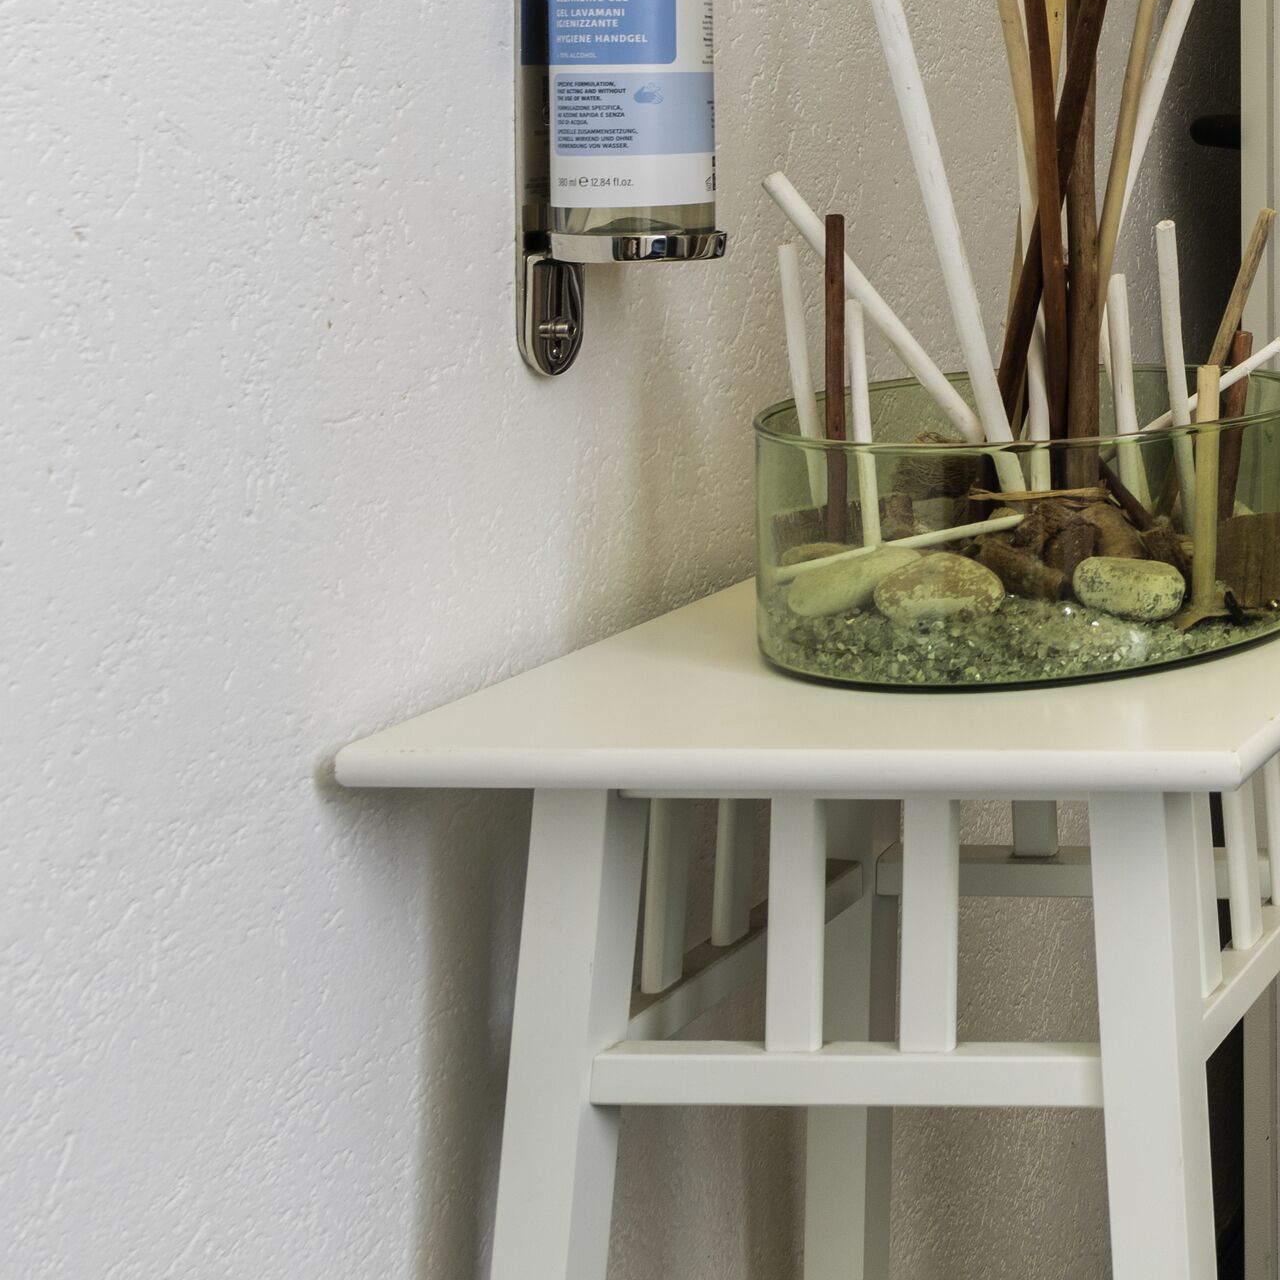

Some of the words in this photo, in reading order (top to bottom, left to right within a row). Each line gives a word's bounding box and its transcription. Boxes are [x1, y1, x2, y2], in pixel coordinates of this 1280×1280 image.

[556, 9, 568, 17] GEL
[571, 8, 625, 17] LAVAMANI
[556, 19, 619, 28] IGIENIZZANTE
[557, 34, 592, 43] HYGIENE
[595, 34, 648, 43] HANDGEL
[591, 177, 611, 187] 12.84
